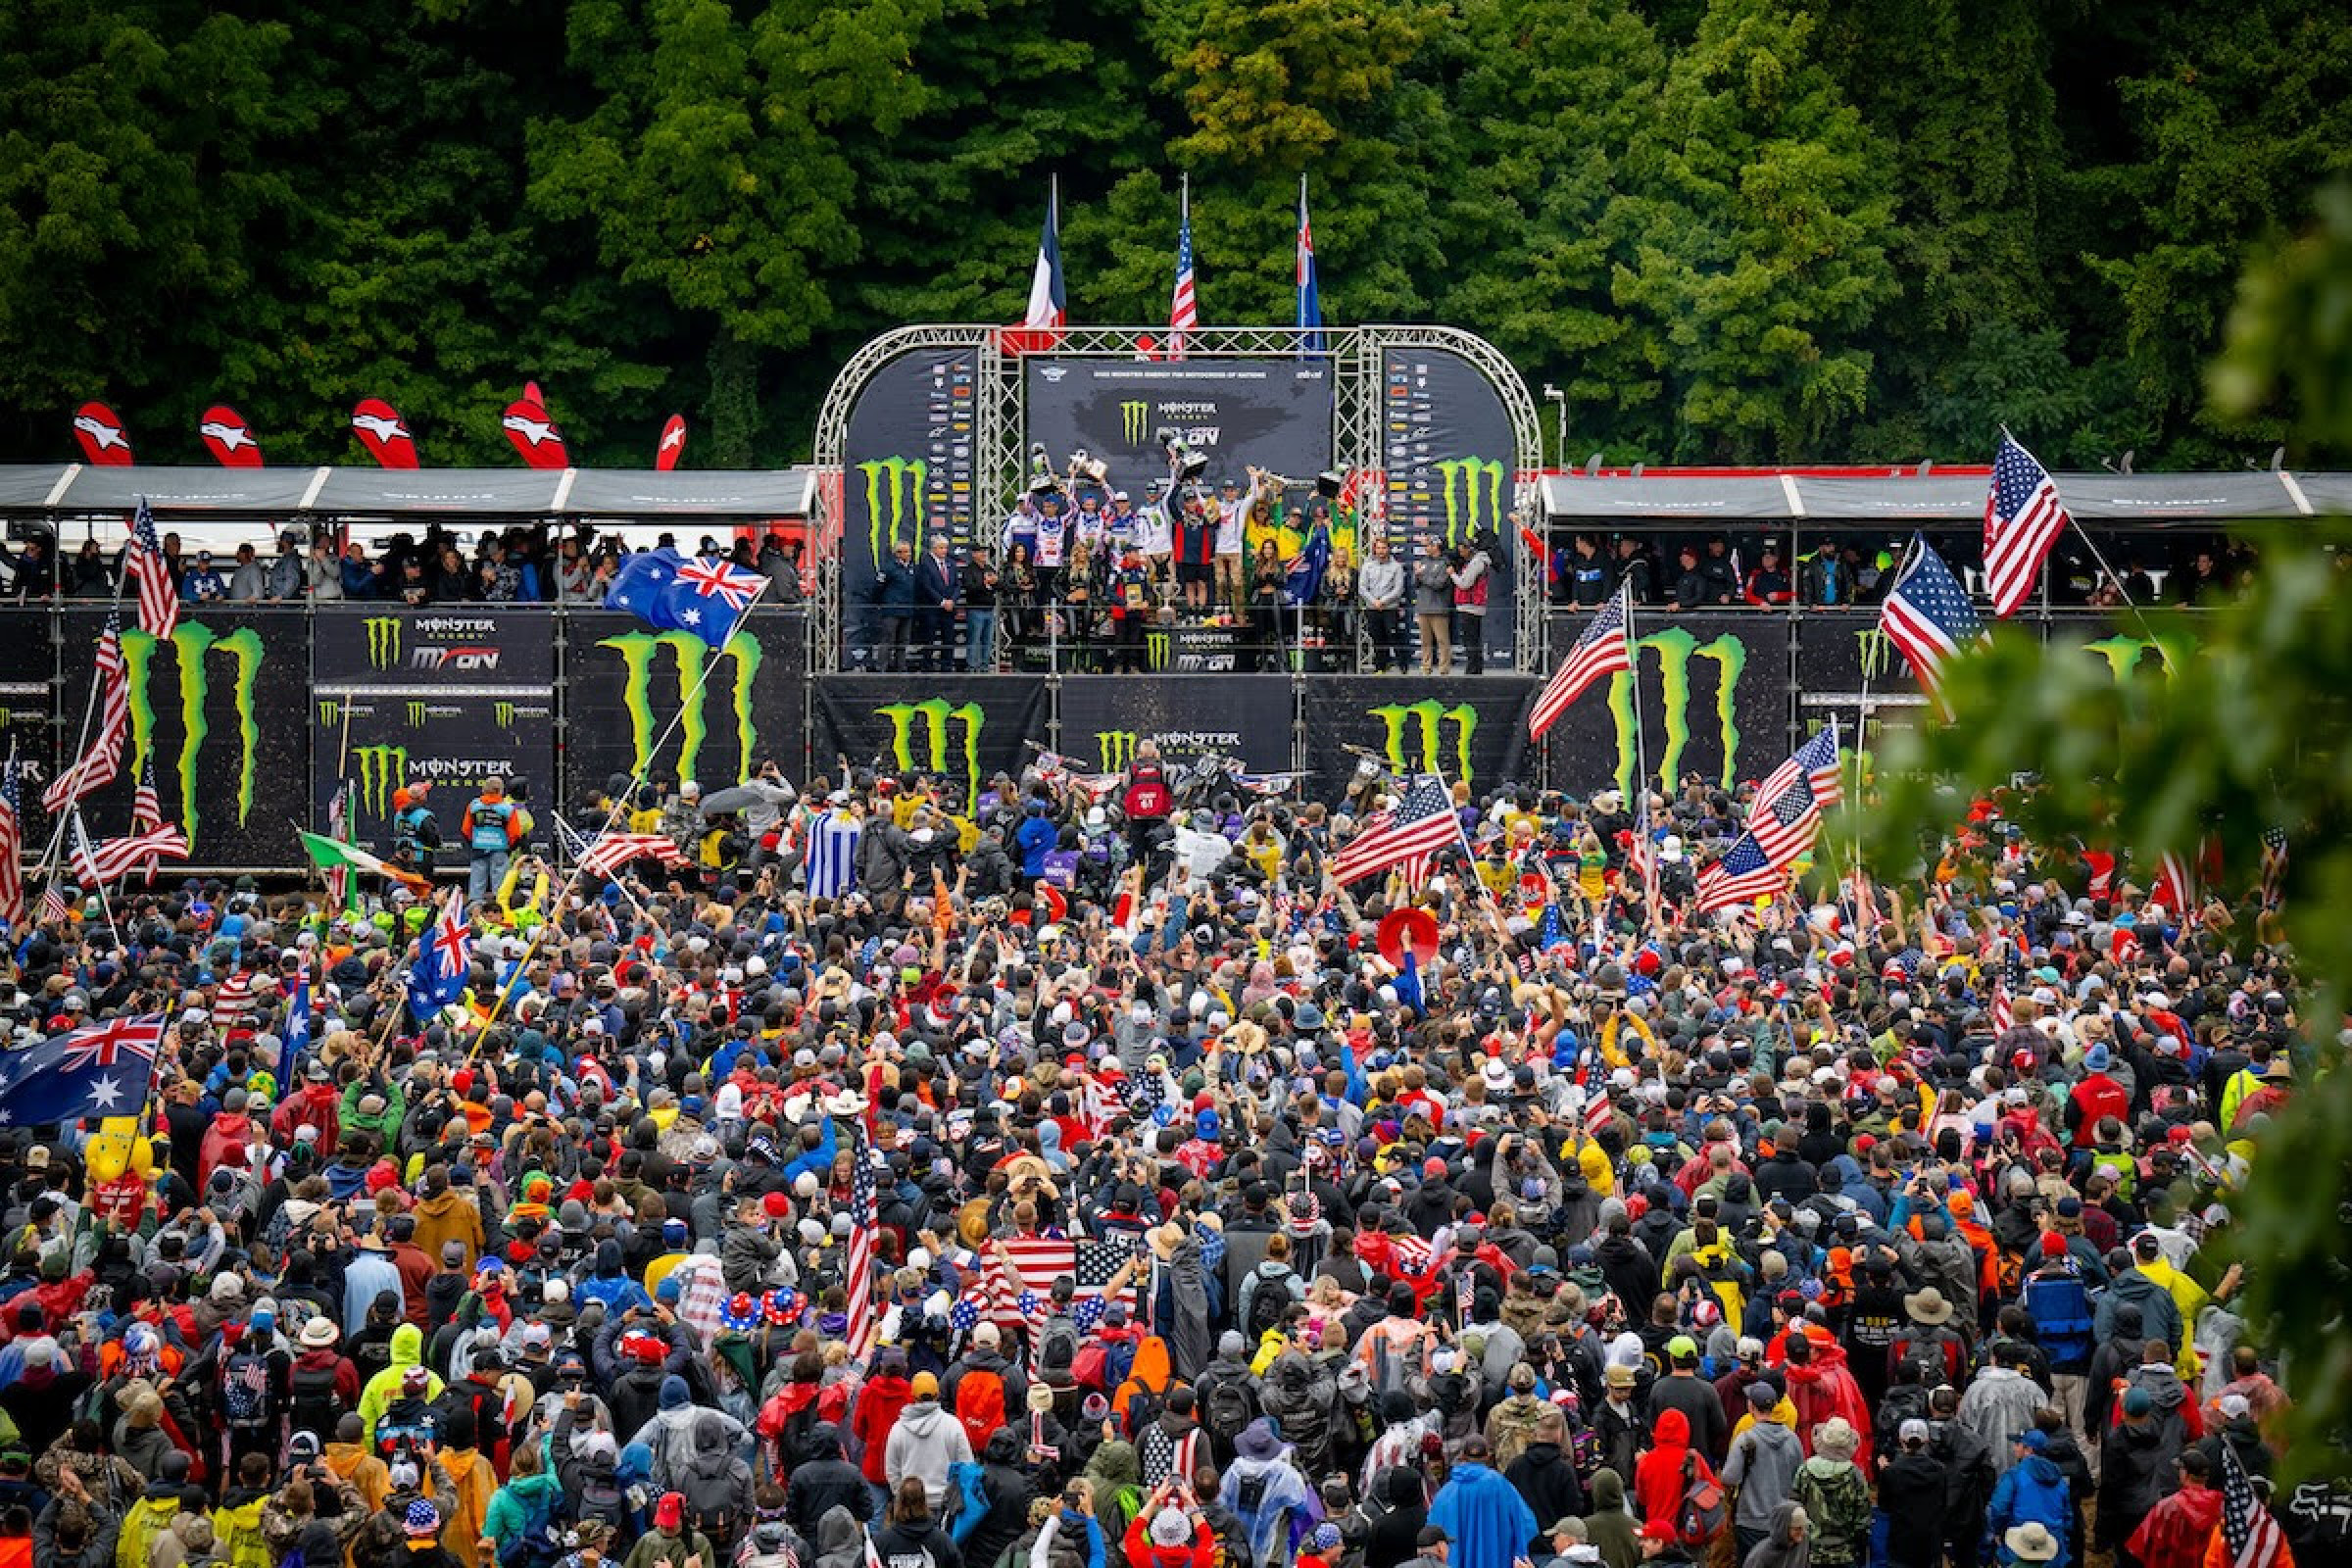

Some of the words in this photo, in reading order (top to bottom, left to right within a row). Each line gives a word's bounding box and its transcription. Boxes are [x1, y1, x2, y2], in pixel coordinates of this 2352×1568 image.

[416, 617, 496, 631] MONSTER
[1152, 730, 1241, 746] MONSTER
[410, 759, 514, 776] MONSTER
